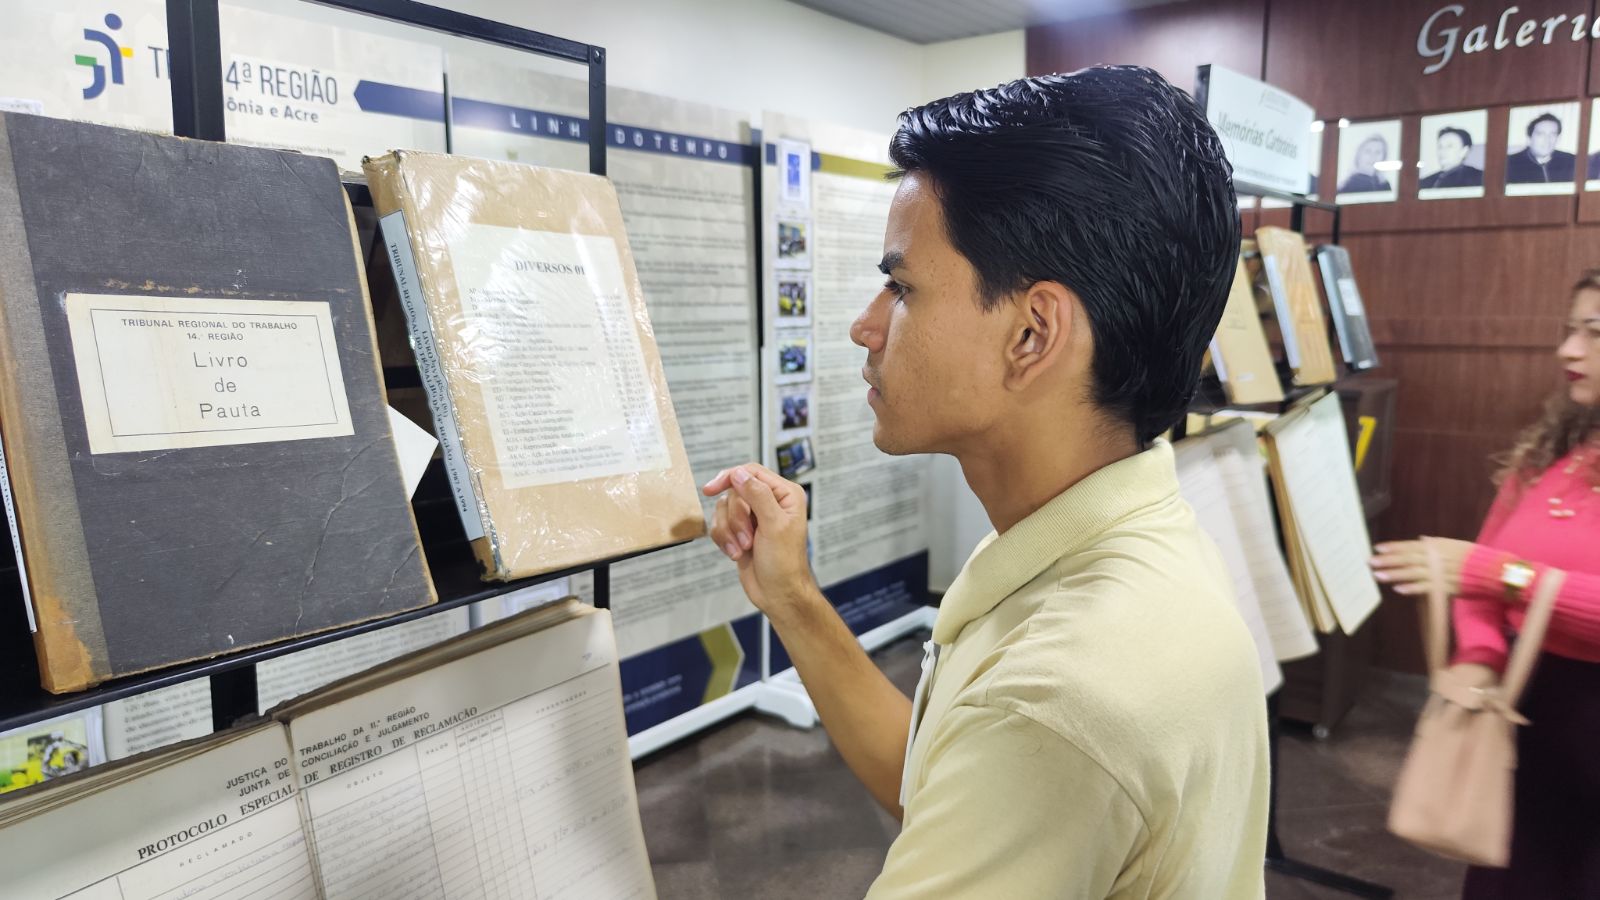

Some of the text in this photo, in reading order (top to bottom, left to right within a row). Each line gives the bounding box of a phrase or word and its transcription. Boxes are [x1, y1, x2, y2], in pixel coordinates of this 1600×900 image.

[226, 60, 252, 91] 4ª
[260, 65, 338, 106] REGIÃO
[227, 97, 319, 123] ônia e Acre
[510, 111, 581, 138] LINH
[654, 136, 728, 159] TEMPO
[514, 260, 573, 274] DIVERSOS
[122, 318, 174, 328] TRIBUNAL
[178, 320, 228, 329] REGIONAL
[250, 322, 298, 330] TRABALHO
[208, 332, 244, 341] REGIÃO
[194, 352, 248, 368] Livro
[214, 378, 237, 393] de
[200, 403, 261, 419] Pauta
[226, 766, 268, 790] JUSTIÇA
[274, 757, 288, 770] DO
[300, 734, 346, 756] TRABALHO
[353, 727, 364, 736] DA
[387, 706, 416, 722] REGIÃO
[239, 779, 271, 797] JUNTA
[278, 769, 291, 780] DE
[302, 740, 358, 767] CONCILIAÇÃO
[378, 712, 429, 737] JULGAMENTO
[138, 813, 228, 860] PROTOCOLO
[240, 784, 295, 816] ESPECIAL
[304, 771, 319, 784] DE
[330, 745, 382, 774] REGISTRO
[392, 736, 406, 749] DE
[414, 706, 477, 739] RECLAMAÇÃO
